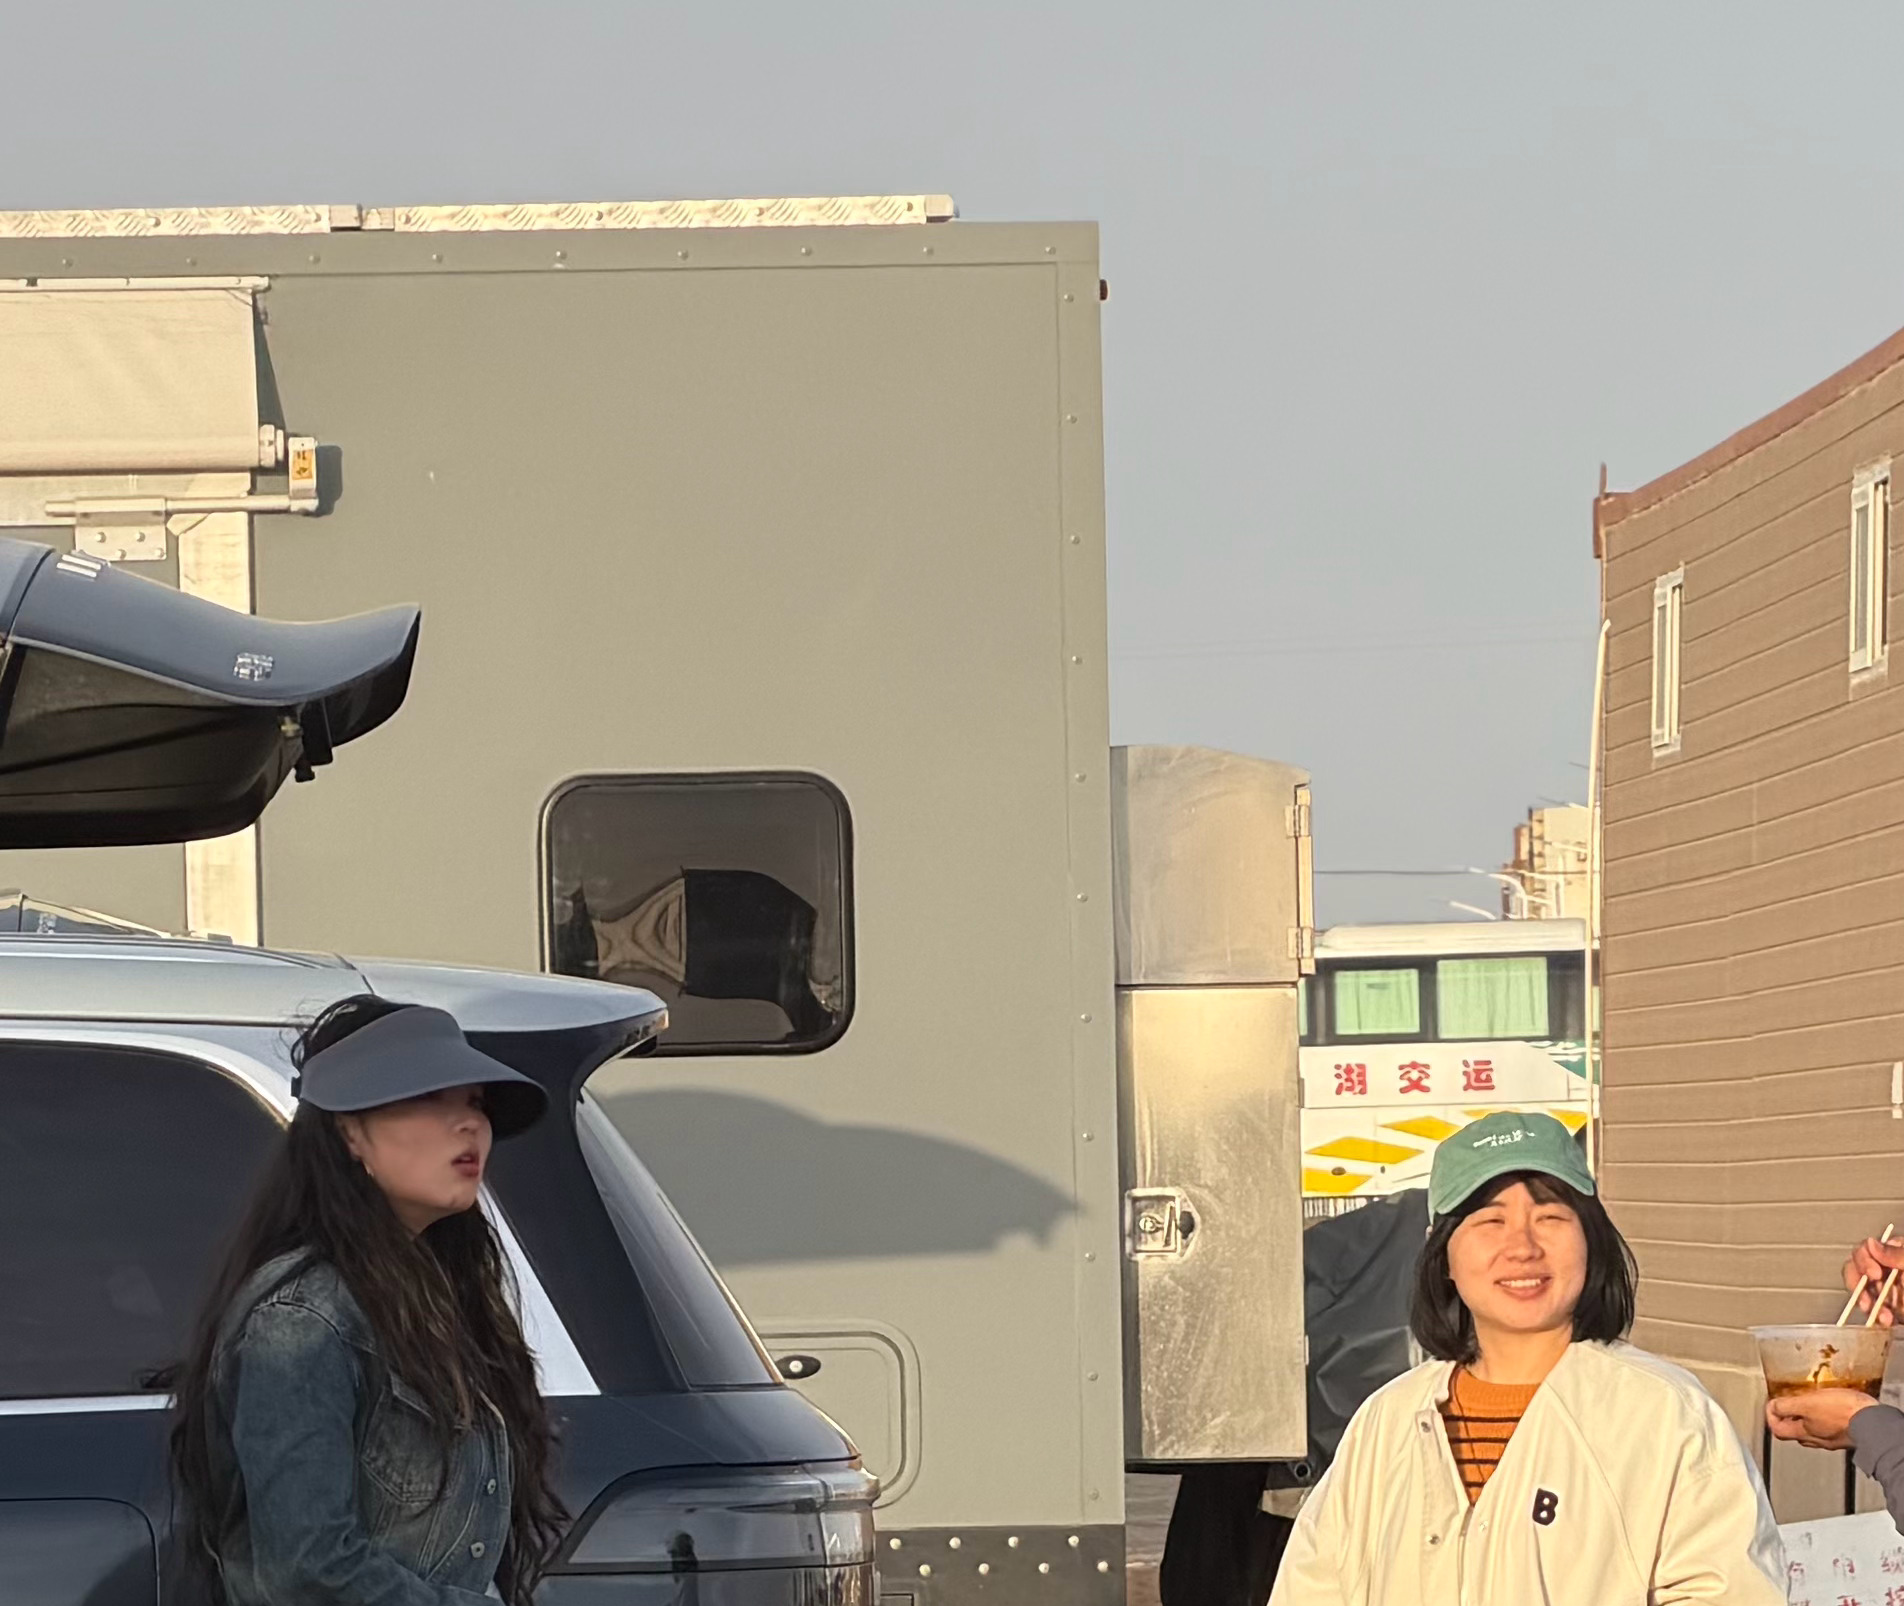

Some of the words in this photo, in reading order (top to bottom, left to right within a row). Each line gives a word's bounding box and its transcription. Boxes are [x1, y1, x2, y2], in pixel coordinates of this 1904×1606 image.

[1334, 1060, 1496, 1096] 湖交运
[1532, 1488, 1559, 1527] B
